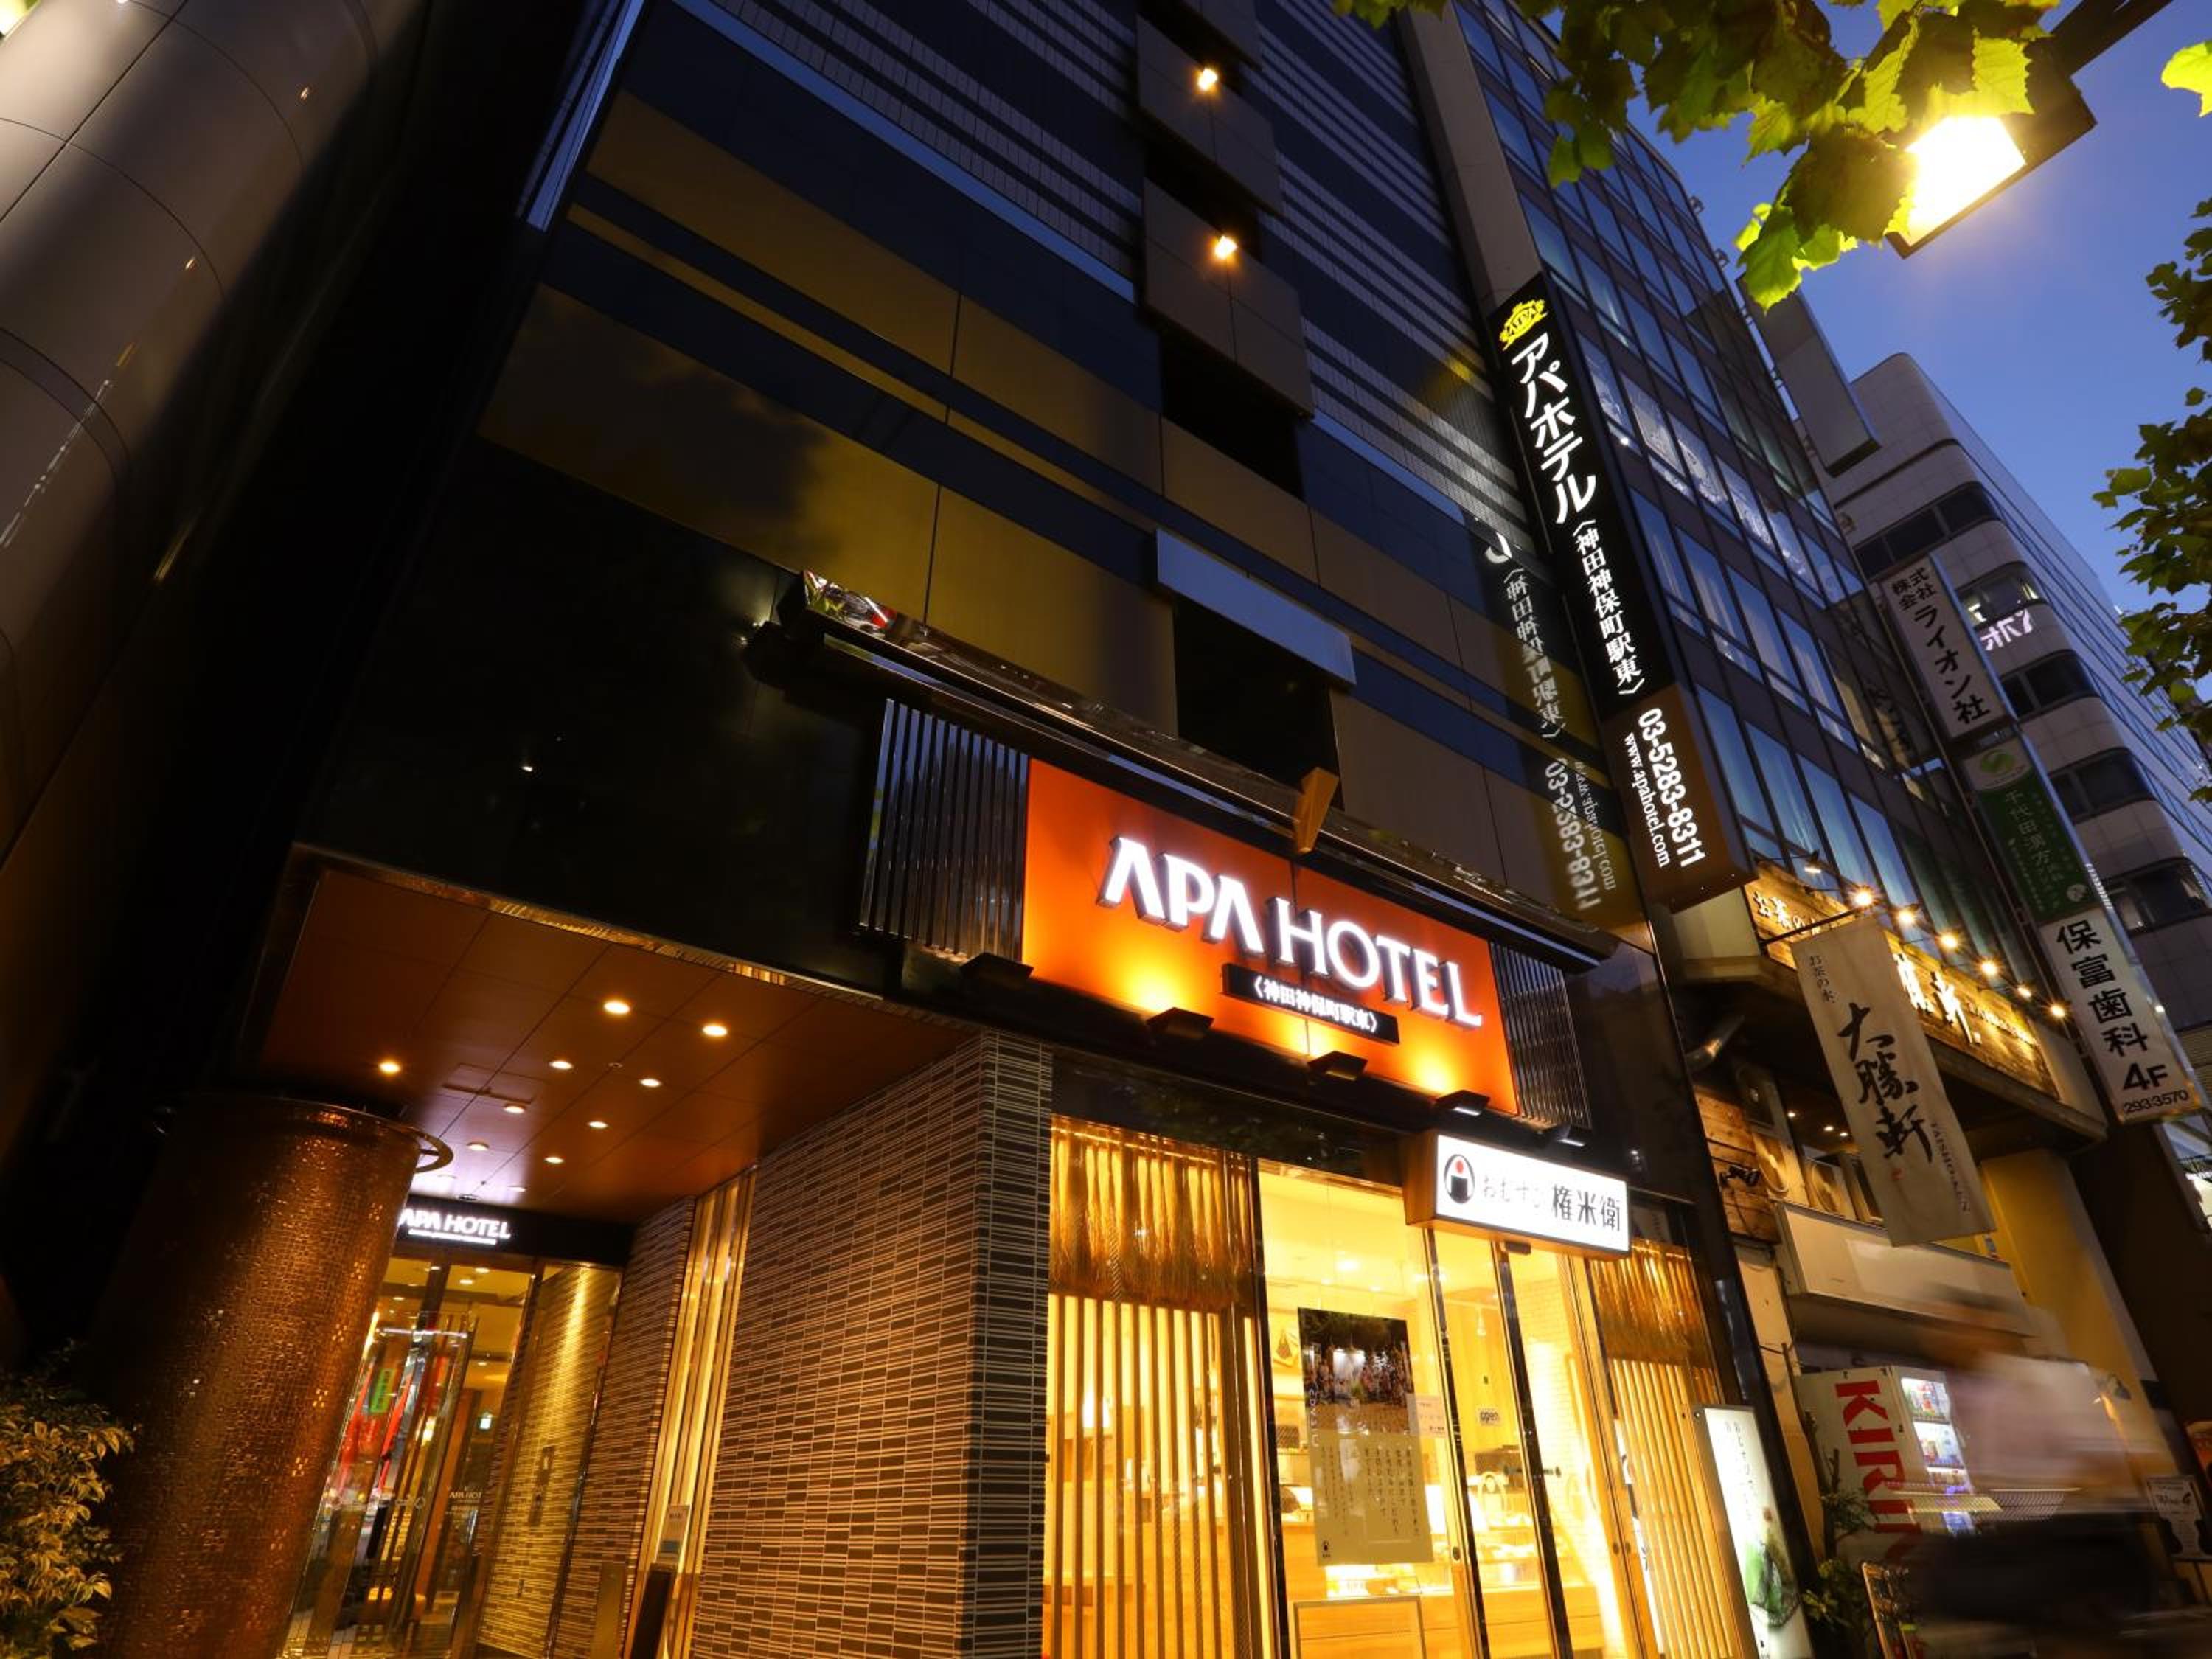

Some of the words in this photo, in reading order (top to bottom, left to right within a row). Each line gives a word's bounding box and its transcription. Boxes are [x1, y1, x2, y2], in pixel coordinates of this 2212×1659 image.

[1511, 333, 1597, 524] アパホテル
[1624, 731, 1670, 868] www.apahotel.com
[1638, 707, 1705, 867] 03-5283-8311
[1100, 836, 1264, 956] APA
[1267, 895, 1484, 1029] HOTEL
[2056, 919, 2148, 1057] 保富歯科
[1837, 1002, 1933, 1164] 大勝軒
[2123, 1062, 2168, 1091] 4F
[397, 1208, 441, 1231] APA
[443, 1214, 512, 1239] HOTEL
[1553, 1183, 1621, 1232] 権米衛
